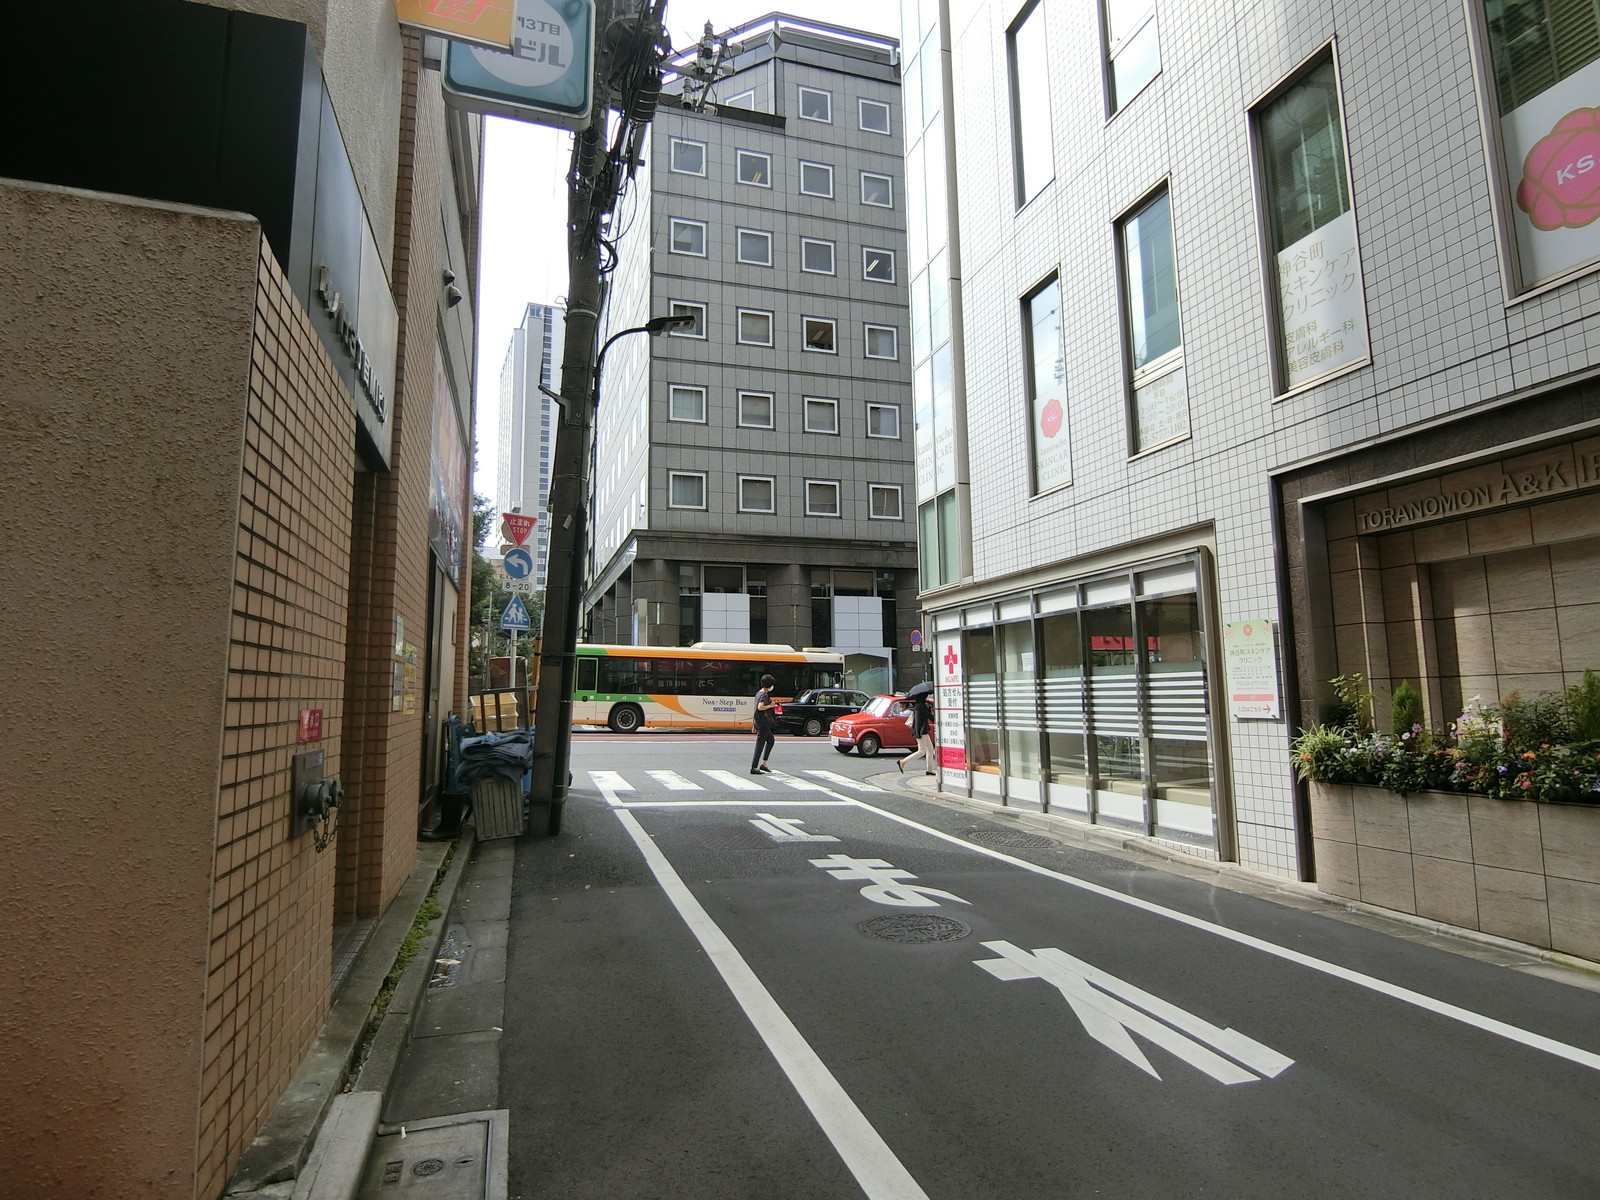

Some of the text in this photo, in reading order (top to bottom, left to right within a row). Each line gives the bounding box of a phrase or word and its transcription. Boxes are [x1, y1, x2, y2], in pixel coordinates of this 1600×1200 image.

[1278, 240, 1325, 279] 神谷町
[1281, 247, 1356, 299] スキンケア
[1283, 272, 1356, 323] クリニック
[1286, 320, 1317, 344] 皮膚科
[1286, 318, 1355, 358] アレルギー科
[1288, 340, 1345, 374] 美容皮膚科
[1042, 463, 1068, 481] CLINIC
[509, 518, 531, 528] 止まれ
[1358, 484, 1492, 530] TORANOMON
[512, 526, 528, 535] STOP
